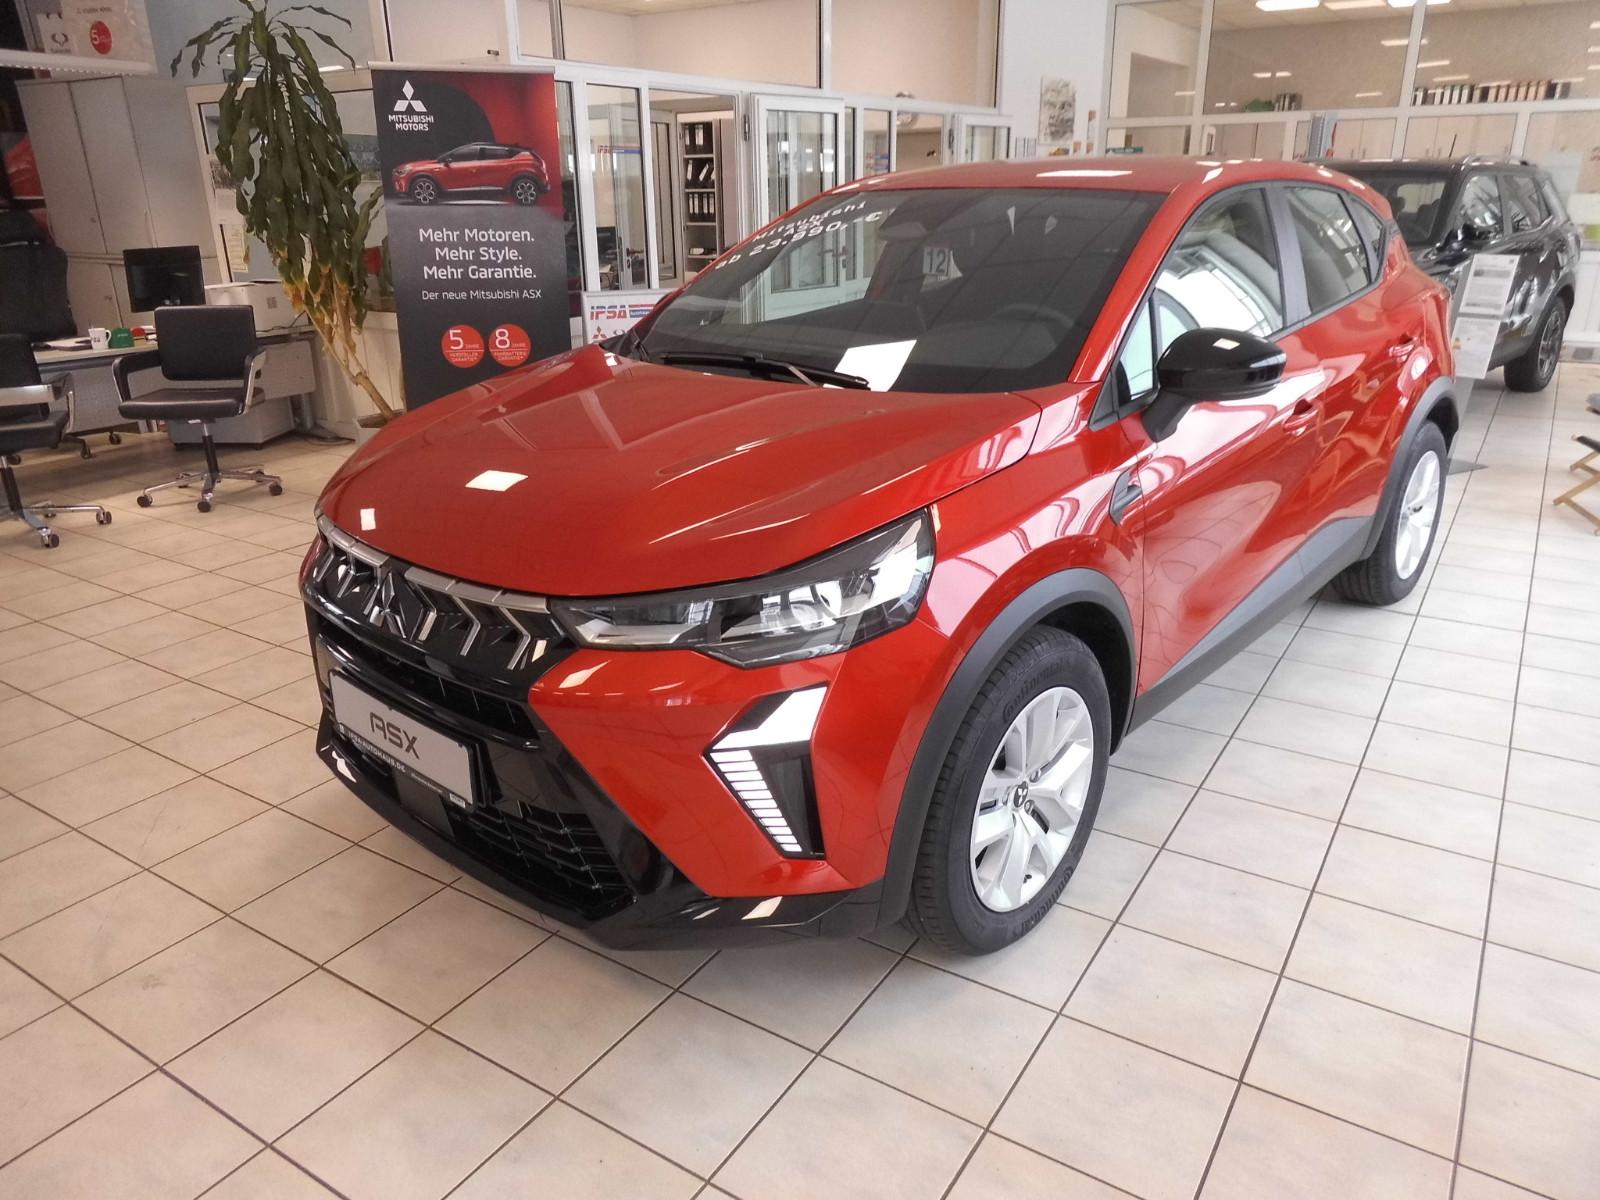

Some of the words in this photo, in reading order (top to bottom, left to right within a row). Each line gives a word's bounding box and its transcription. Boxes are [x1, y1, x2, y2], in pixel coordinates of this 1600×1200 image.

[388, 114, 434, 123] MITSUBISHI
[395, 123, 429, 131] MOTORS
[753, 201, 867, 242] Mitsubishi
[419, 227, 460, 242] Mehr
[464, 228, 535, 242] Motoren.
[435, 246, 475, 261] Mehr
[479, 246, 522, 263] Style.
[715, 254, 741, 270] ab
[423, 265, 464, 279] Mehr
[468, 264, 537, 279] Garantie.
[421, 290, 440, 300] Der
[442, 291, 467, 300] neue
[470, 289, 520, 300] Mitsubishi
[522, 289, 542, 299] ASX
[590, 304, 628, 321] IPSA
[449, 328, 464, 350] 5
[495, 328, 511, 349] 8
[369, 711, 419, 760] ASX
